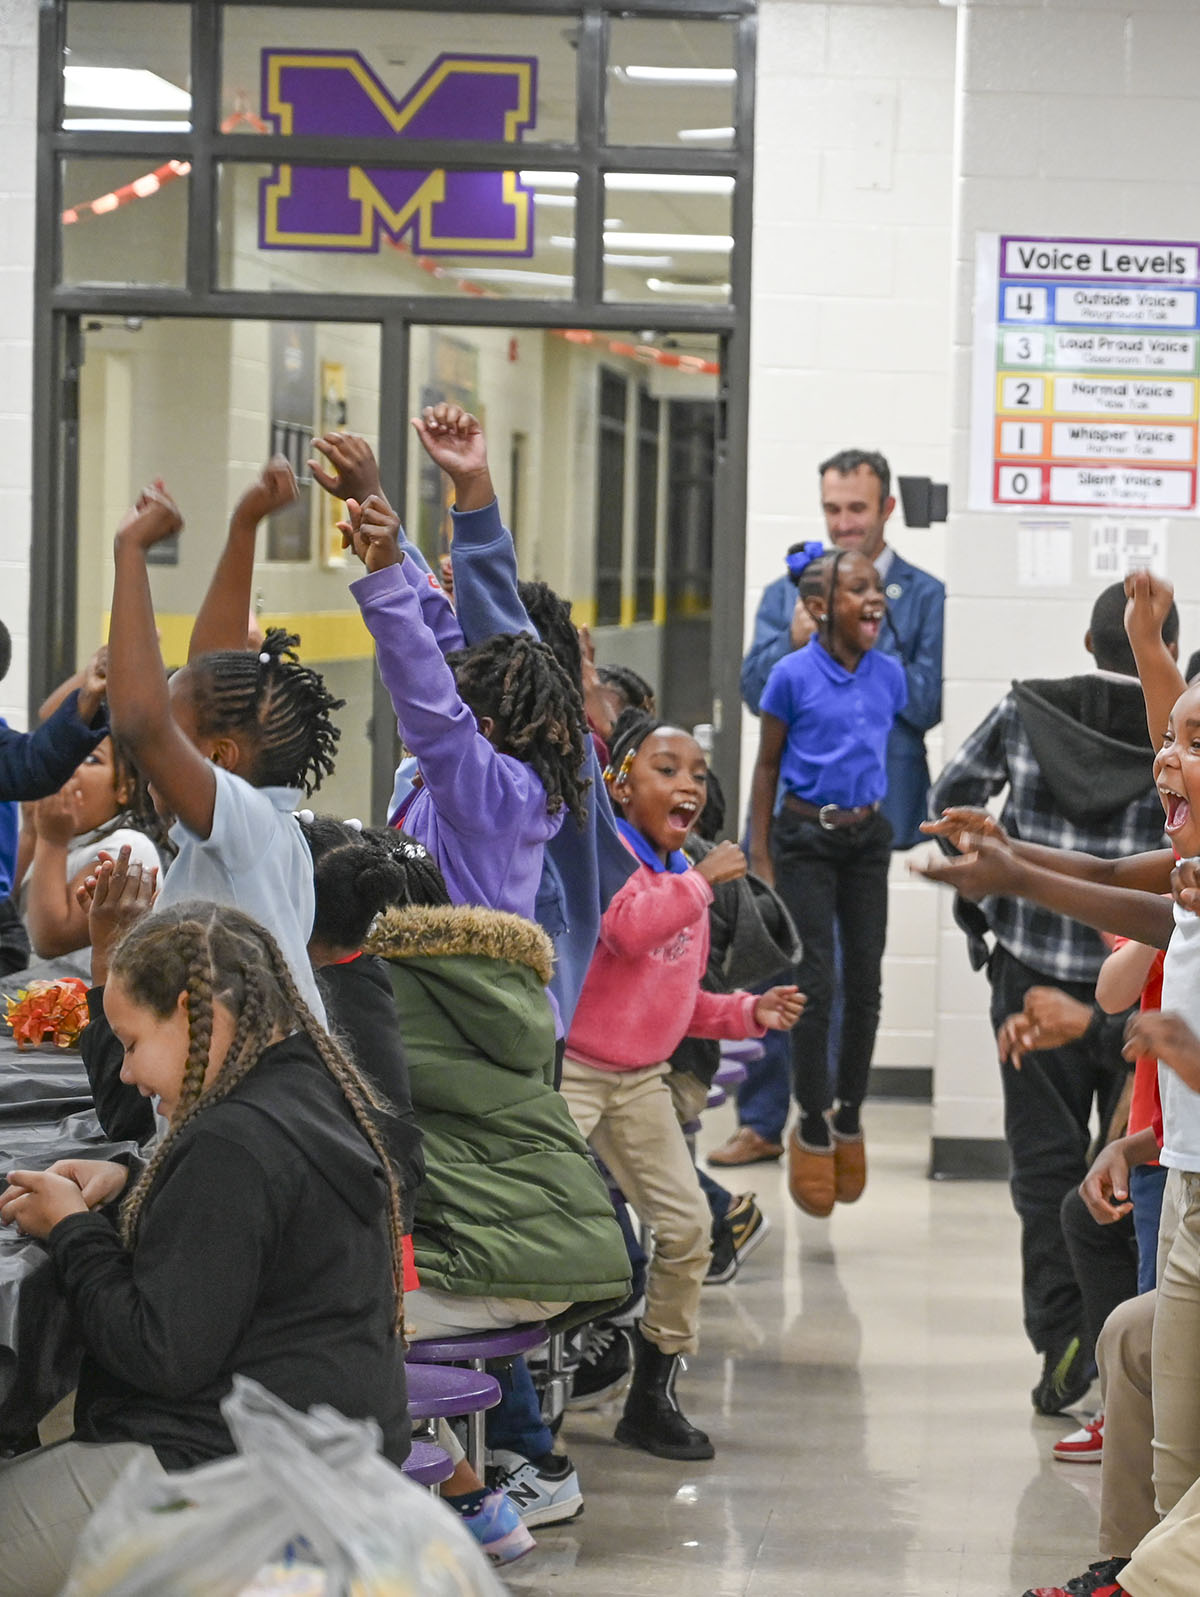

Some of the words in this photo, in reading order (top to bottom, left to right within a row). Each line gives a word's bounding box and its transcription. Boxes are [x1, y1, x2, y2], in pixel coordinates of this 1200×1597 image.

[259, 48, 538, 258] M
[1018, 246, 1091, 271] Voice
[1101, 249, 1186, 274] Levels
[1017, 292, 1032, 314] 4
[1073, 291, 1131, 306] Outside
[1137, 293, 1178, 308] Voice
[1017, 337, 1031, 360] 3
[1058, 337, 1095, 350] Loud
[1099, 337, 1143, 351] Proud
[1148, 339, 1190, 353] Voice
[1016, 382, 1031, 405] 2
[1072, 383, 1128, 396] Normal
[1133, 384, 1175, 398] Voice
[1068, 426, 1128, 443] Whisper
[1135, 428, 1176, 443] Voice
[1012, 472, 1028, 494] 0
[1078, 472, 1116, 485] Silent
[1122, 473, 1163, 487] Voice
[506, 1481, 540, 1508] N
